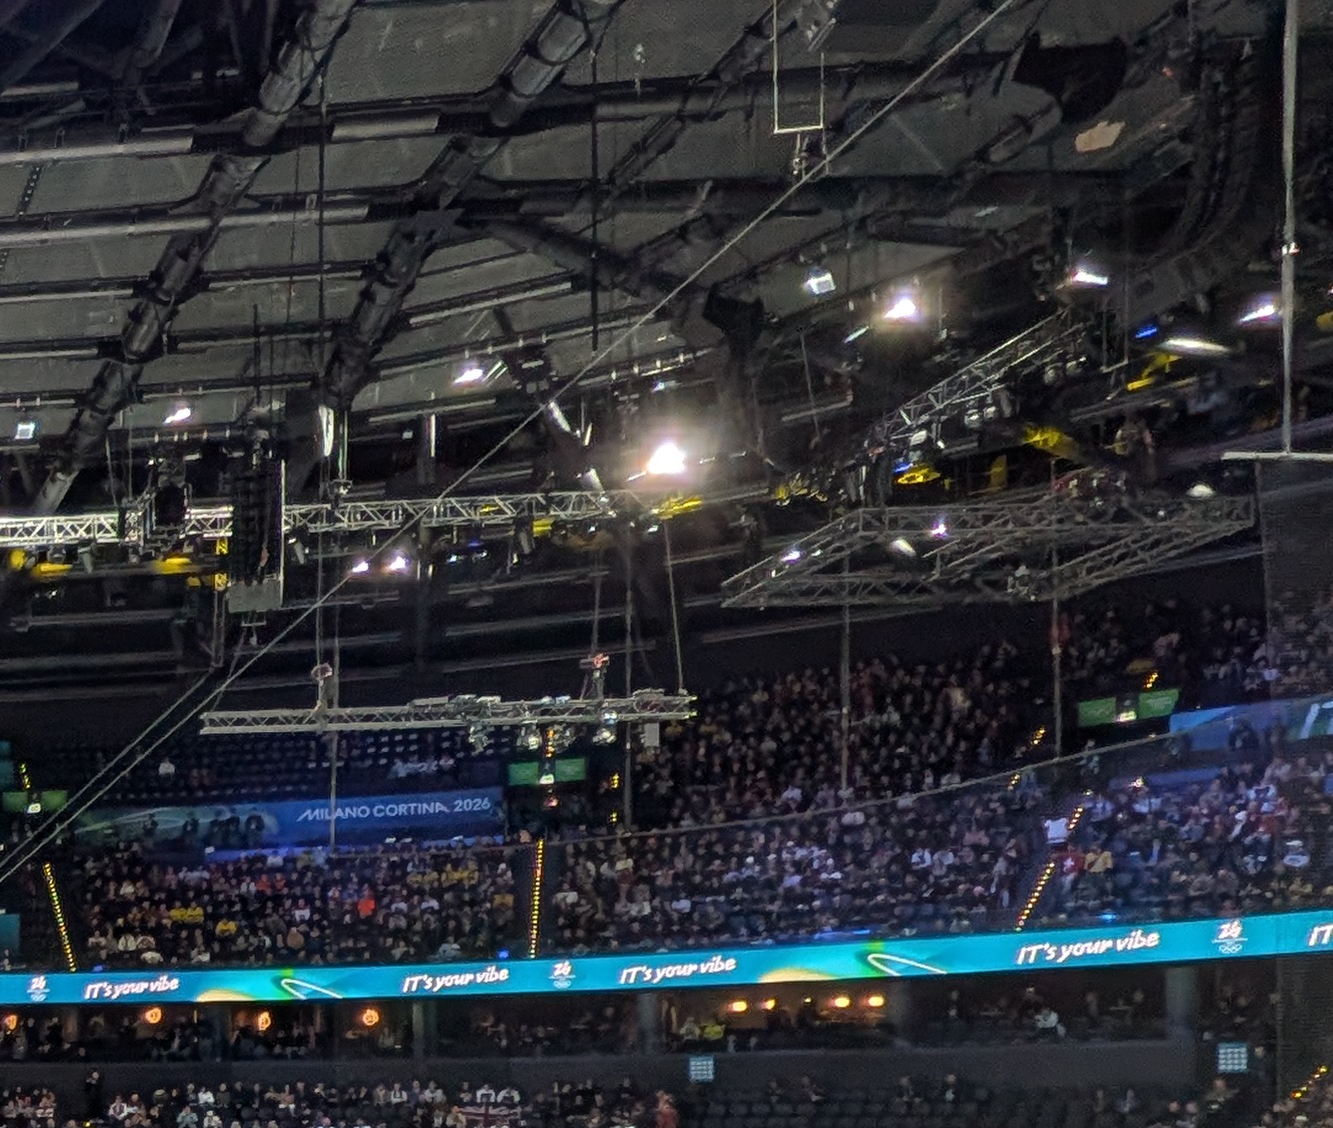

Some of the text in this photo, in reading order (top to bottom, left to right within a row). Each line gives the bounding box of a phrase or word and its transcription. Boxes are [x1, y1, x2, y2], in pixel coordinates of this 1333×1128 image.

[296, 797, 491, 822] MILANO CORTINA 2026
[1056, 938, 1113, 963] your
[1116, 929, 1161, 952] vibe
[1308, 924, 1333, 947] IT
[433, 971, 474, 992] your
[475, 965, 510, 983] vibe
[651, 962, 697, 984] your
[700, 954, 737, 973] vibe
[111, 980, 148, 1000] your
[149, 974, 180, 991] vibe
